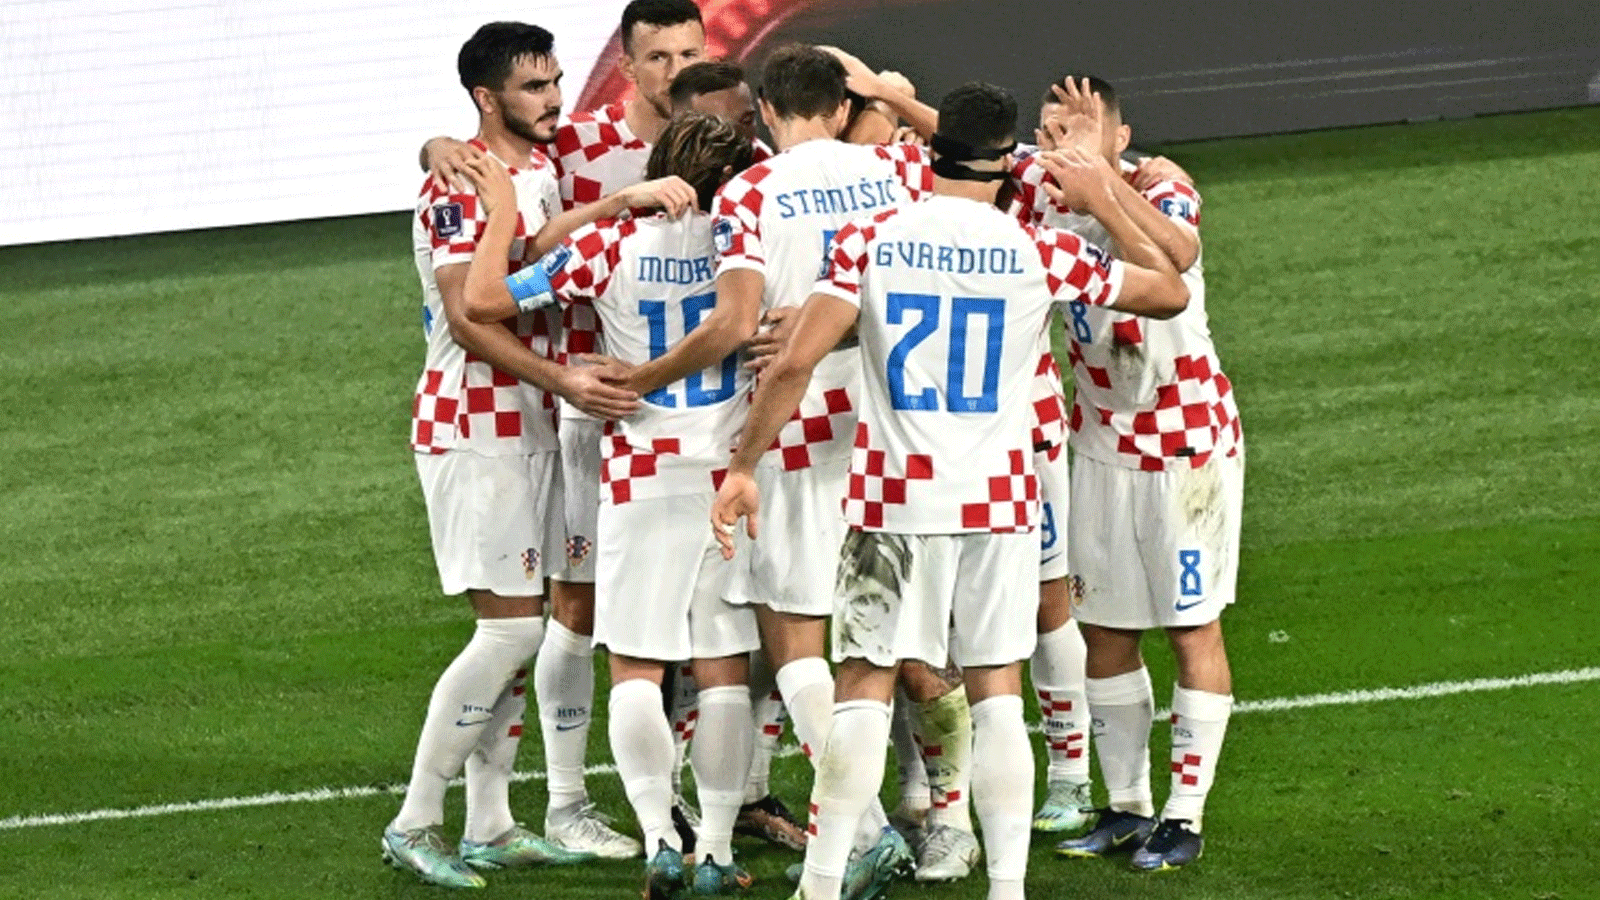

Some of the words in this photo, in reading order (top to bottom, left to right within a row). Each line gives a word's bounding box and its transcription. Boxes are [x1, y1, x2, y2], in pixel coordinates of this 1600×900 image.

[638, 256, 714, 285] MODR
[876, 242, 1024, 275] GVARDIOL
[1069, 300, 1092, 344] 8
[638, 291, 737, 408] 10
[886, 292, 1006, 413] 20
[1179, 549, 1202, 596] 8
